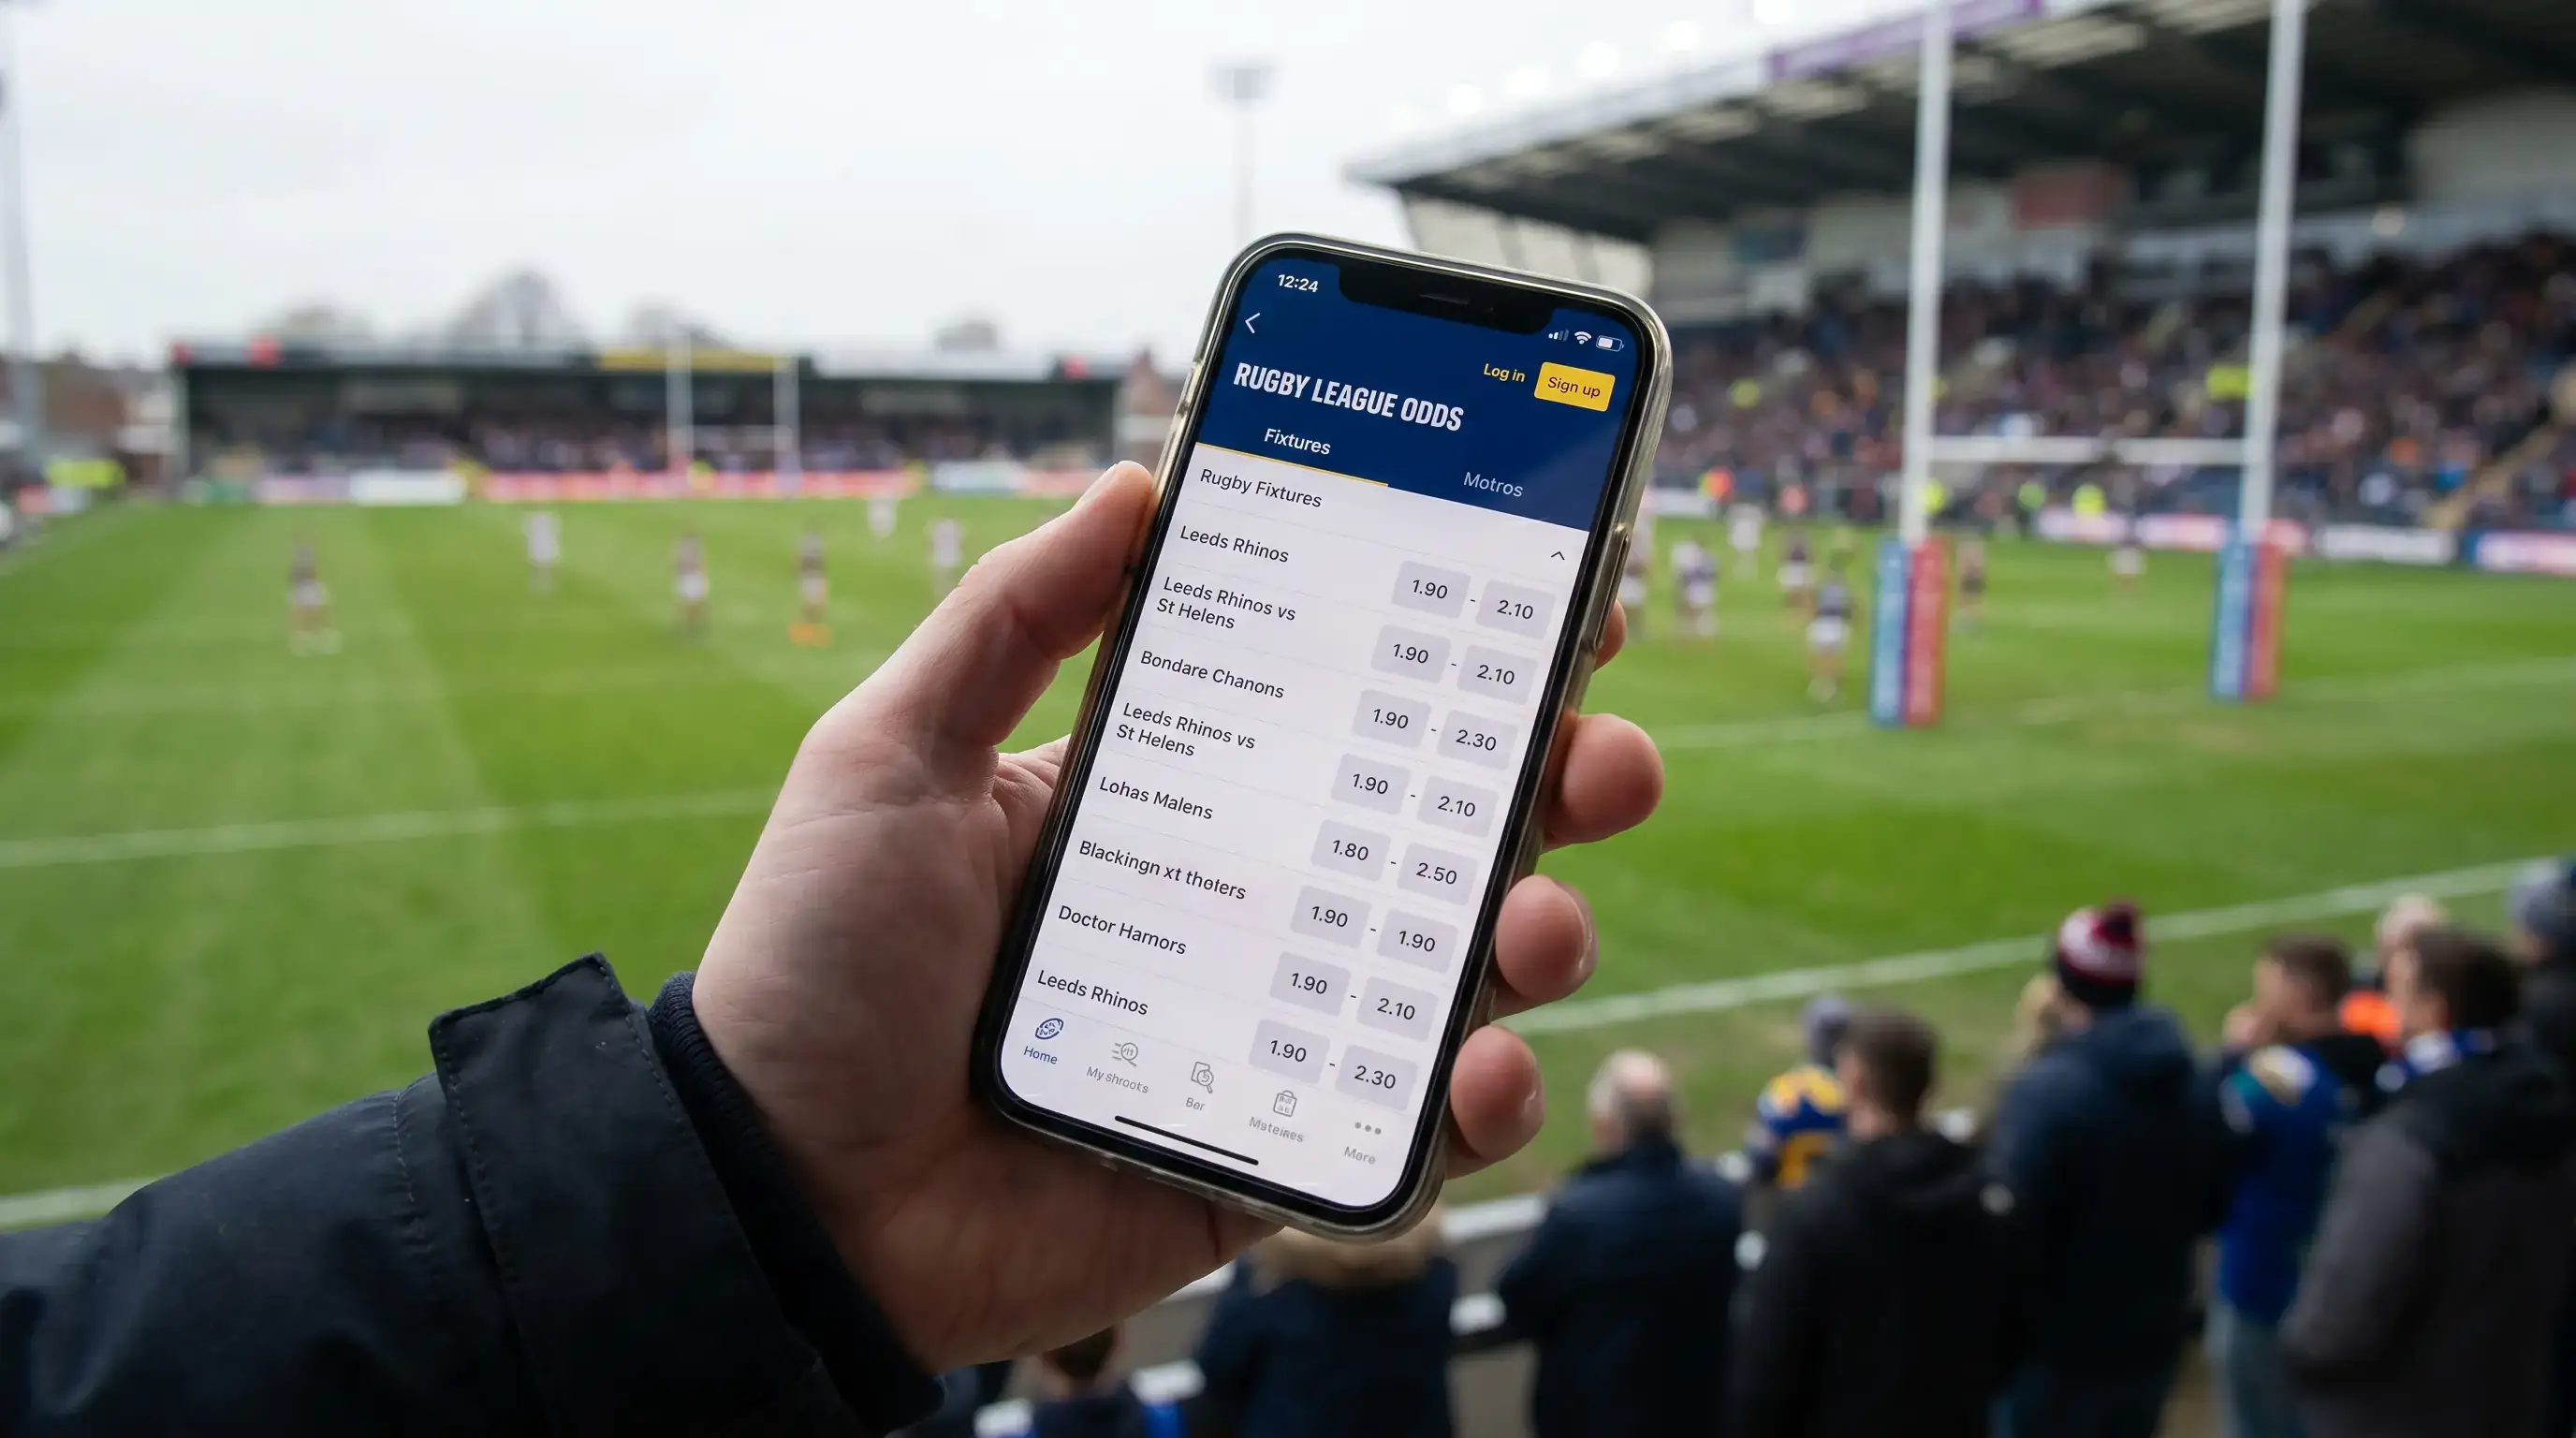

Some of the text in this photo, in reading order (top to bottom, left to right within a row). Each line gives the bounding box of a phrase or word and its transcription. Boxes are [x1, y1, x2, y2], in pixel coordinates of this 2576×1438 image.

[1278, 273, 1319, 293] 12:24
[1483, 362, 1526, 383] Log in
[1547, 376, 1601, 399] Sign up
[1233, 361, 1464, 432] RUGBY LEAGUE ODDS
[1264, 428, 1331, 455] Fixtures
[1200, 468, 1323, 507] Rugby Fixtures
[1463, 471, 1524, 498] Motros
[1179, 525, 1289, 563] Leeds Rhinos
[1156, 597, 1236, 629] St Helens
[1163, 576, 1296, 621] Leeds Rhinos vs
[1412, 580, 1448, 599] 1.90
[1497, 599, 1534, 620] 2.10
[1140, 650, 1284, 698] Bondare Chanons
[1393, 643, 1429, 664] 1.90
[1476, 664, 1515, 685] 2.10
[1116, 724, 1195, 756] St Helens
[1122, 702, 1255, 749] Leeds Rhinos vs
[1373, 709, 1409, 729] 1.90
[1456, 728, 1497, 752] 2.30
[1099, 776, 1213, 820] Lohas Malens
[1353, 773, 1389, 795] 1.90
[1437, 795, 1476, 817] 2.10
[1079, 840, 1161, 876] Blackingn
[1163, 866, 1182, 882] xt
[1333, 839, 1369, 861] 1.80
[1415, 862, 1457, 885] 2.50
[1058, 904, 1117, 933] Doctor
[1311, 905, 1348, 928] 1.90
[1398, 931, 1436, 952] 1.90
[1037, 969, 1149, 1016] Leeds Rhinos
[1292, 972, 1327, 995] 1.90
[1376, 997, 1415, 1020] 2.10
[1023, 1045, 1058, 1064] Home
[1086, 1065, 1105, 1081] My
[1270, 1039, 1307, 1063] 1.90
[1354, 1064, 1397, 1090] 2.30
